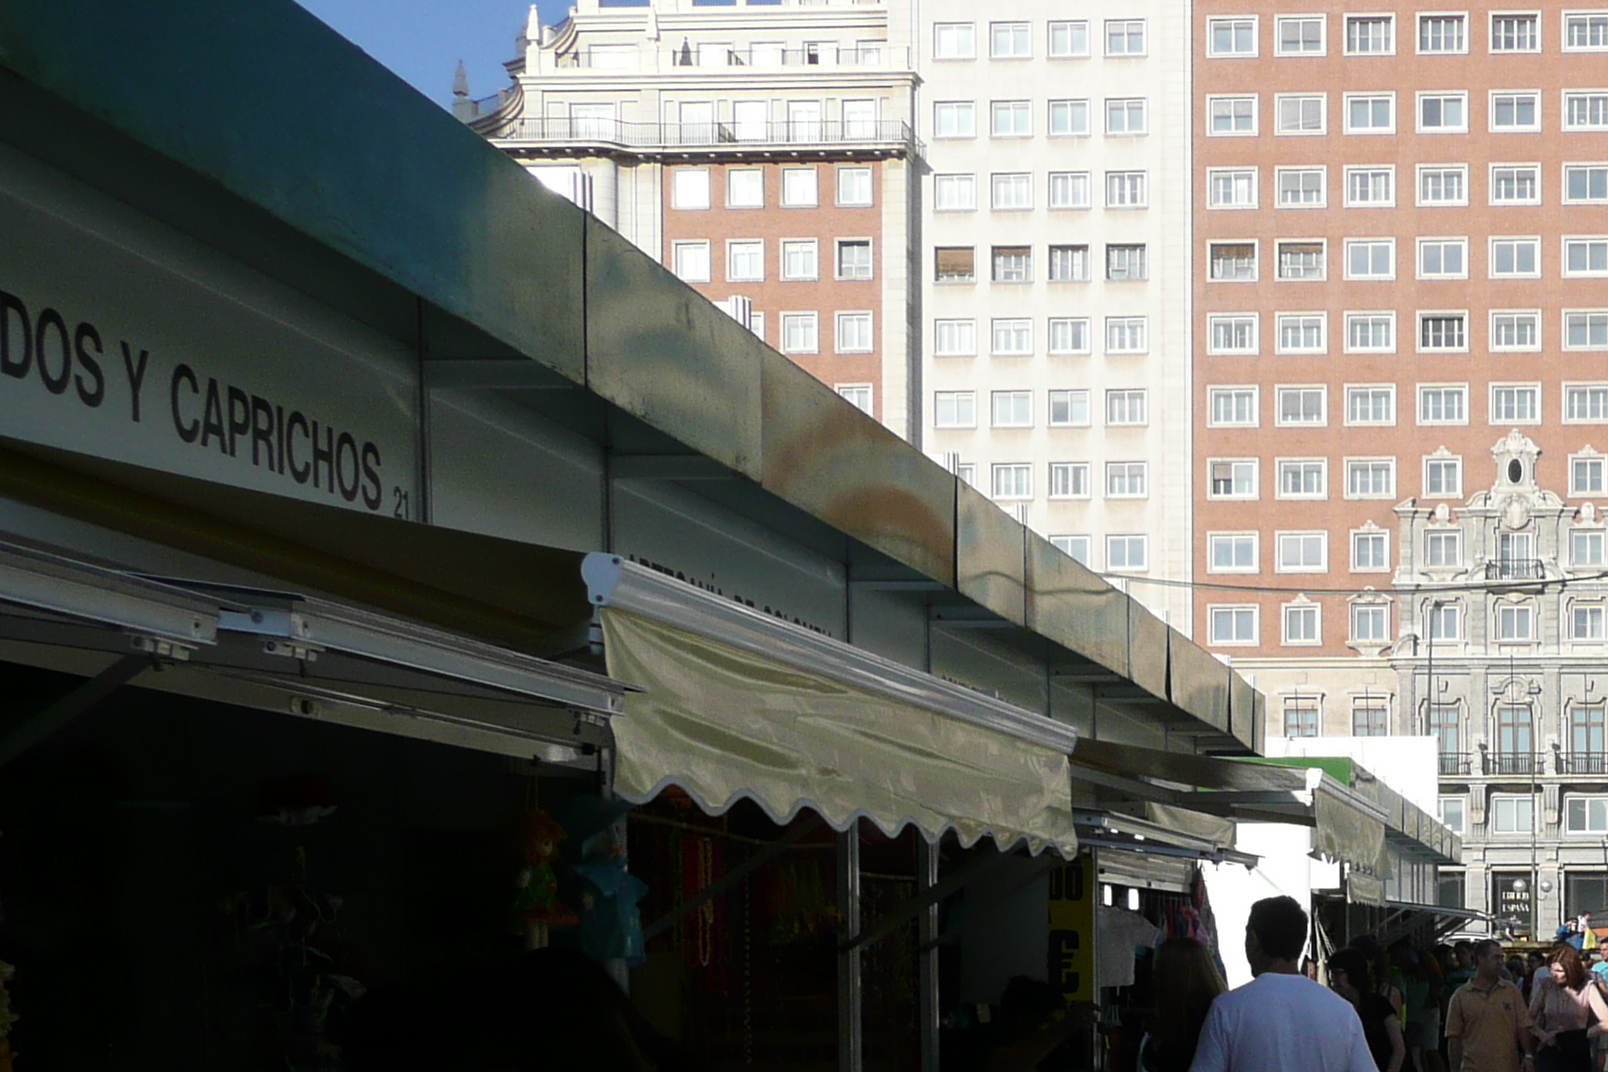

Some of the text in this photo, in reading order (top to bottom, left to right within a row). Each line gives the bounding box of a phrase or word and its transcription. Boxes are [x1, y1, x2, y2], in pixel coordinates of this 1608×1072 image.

[0, 290, 383, 512] DOS Y CAPRICHOS
[393, 485, 410, 520] 21
